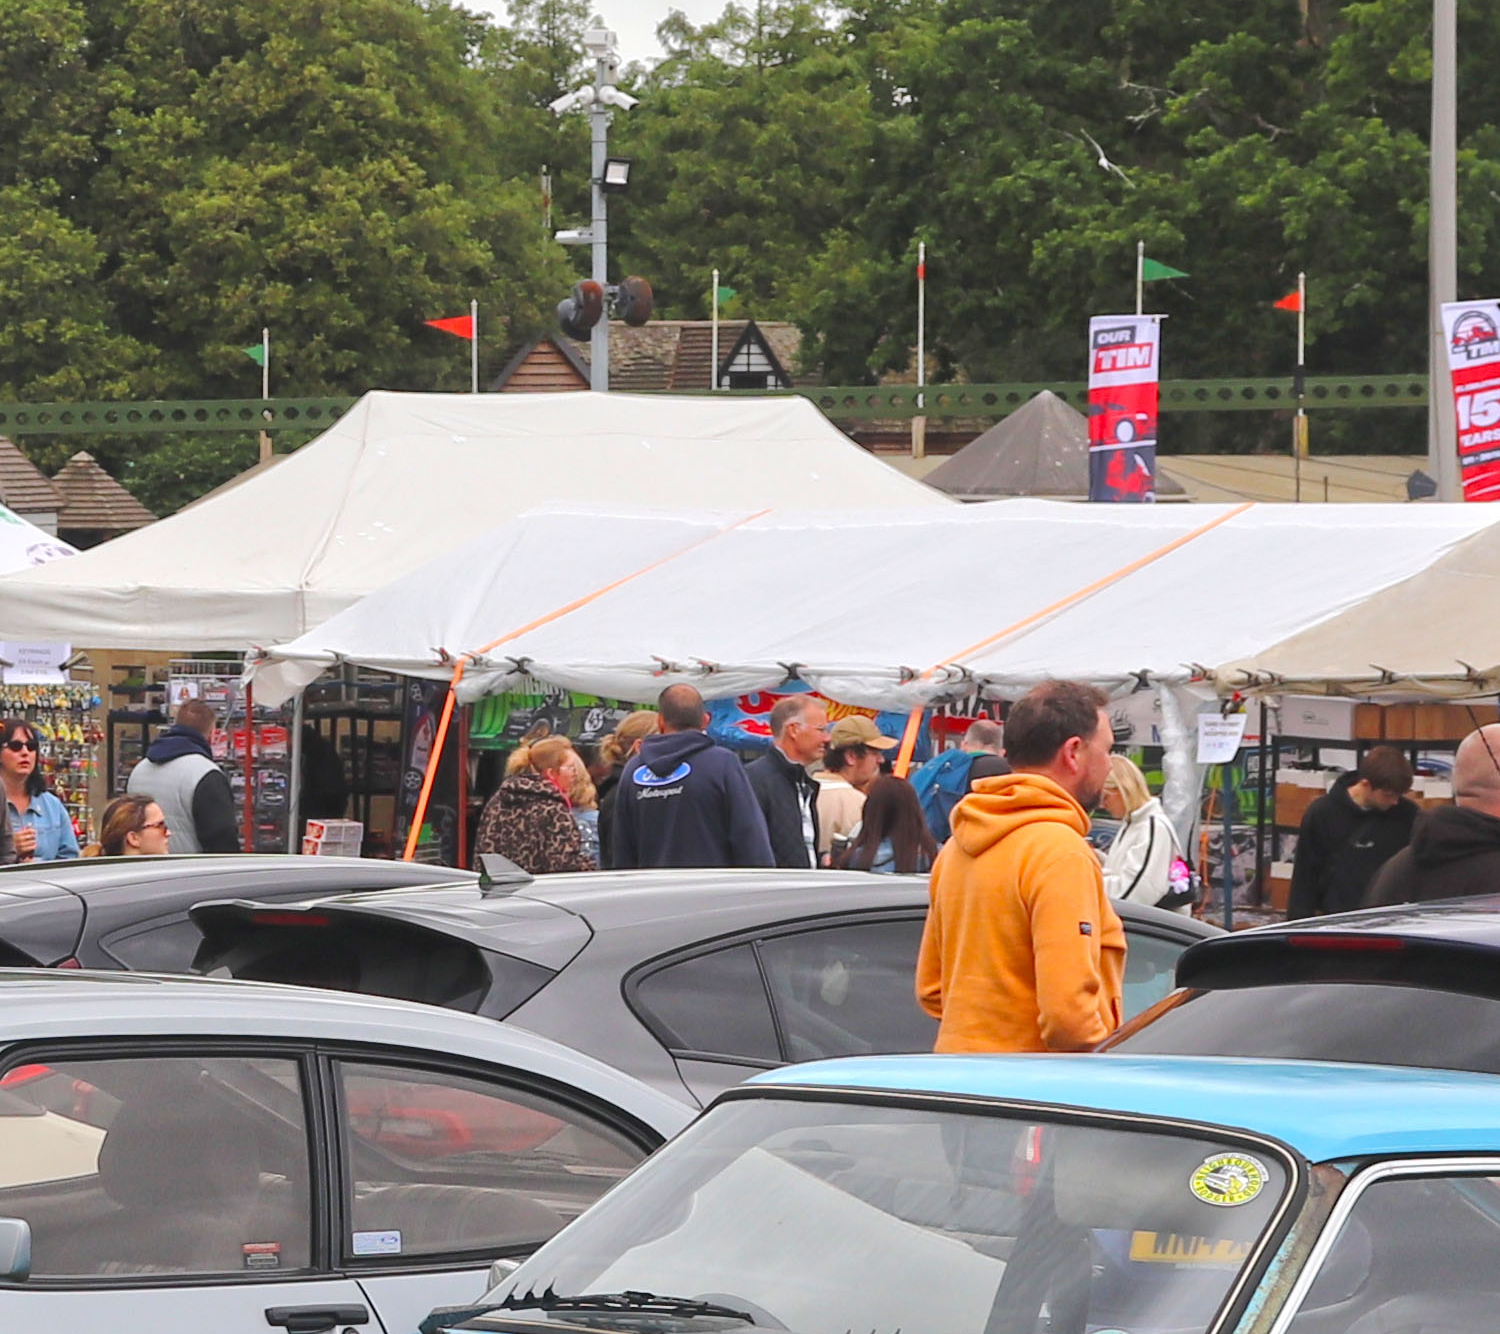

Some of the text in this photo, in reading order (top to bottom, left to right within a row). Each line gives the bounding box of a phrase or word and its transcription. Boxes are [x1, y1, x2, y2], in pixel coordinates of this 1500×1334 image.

[1096, 329, 1132, 344] OUR
[1098, 346, 1151, 370] TIM
[1467, 341, 1500, 358] TIM
